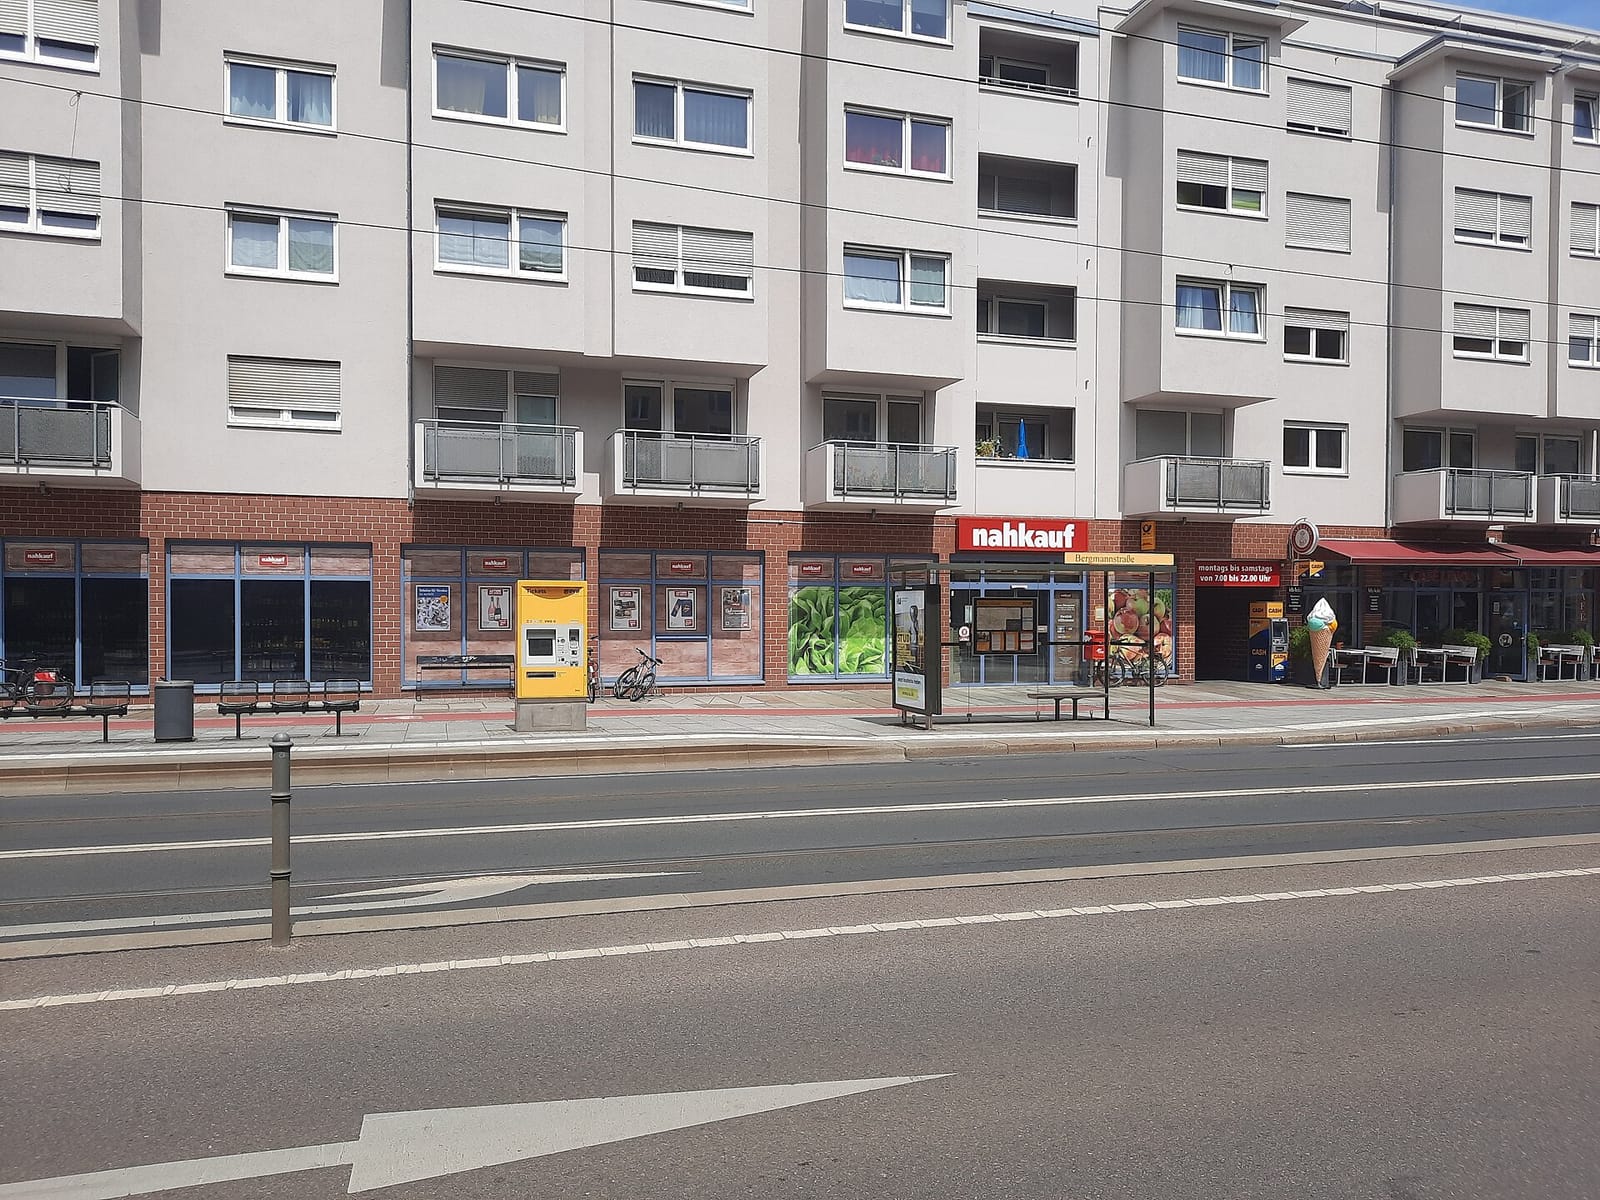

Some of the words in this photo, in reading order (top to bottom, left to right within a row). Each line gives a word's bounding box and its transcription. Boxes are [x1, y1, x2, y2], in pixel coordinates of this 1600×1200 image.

[972, 522, 1075, 548] nahkauf
[1075, 554, 1136, 564] Bergmannstraße
[1198, 564, 1229, 573] montags
[1229, 564, 1240, 572] bis
[1241, 565, 1273, 574] samstags
[1214, 574, 1228, 582] 7.00
[1228, 574, 1239, 582] bis
[1240, 574, 1258, 582] 22.00
[1258, 574, 1272, 582] Uhr
